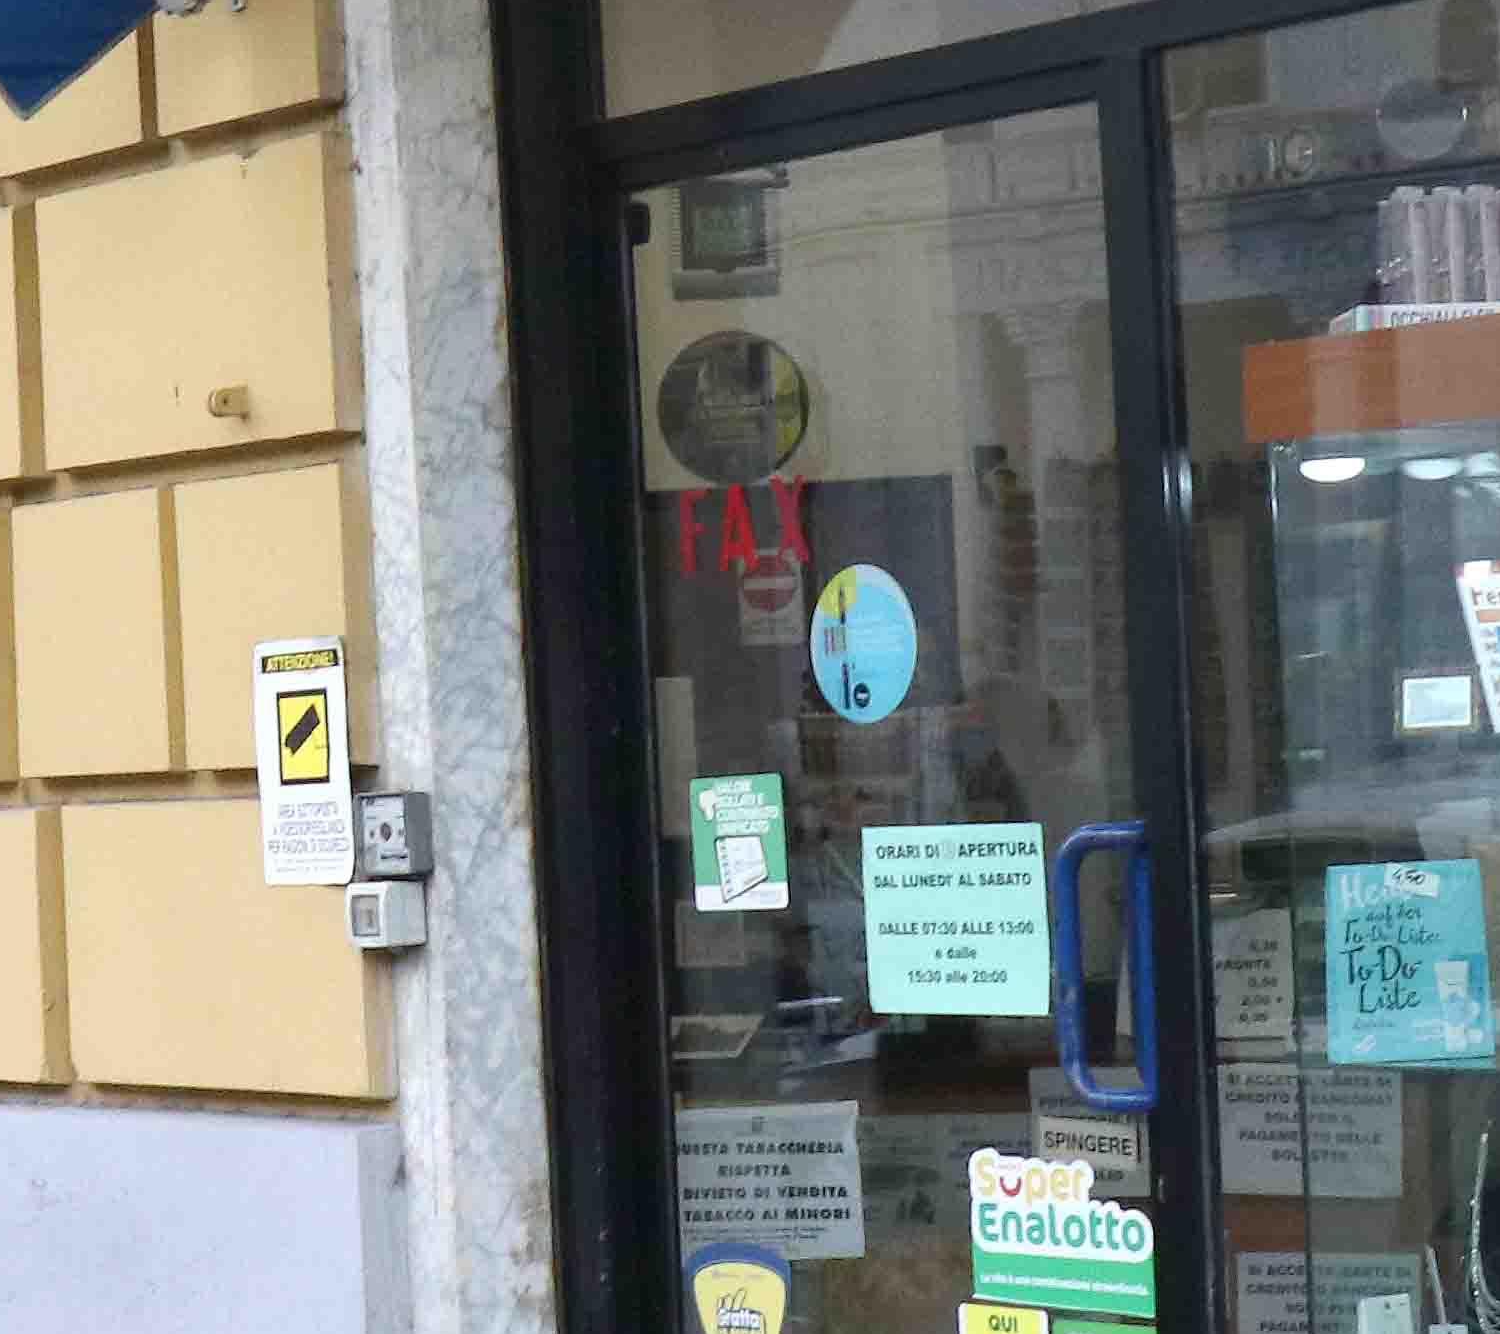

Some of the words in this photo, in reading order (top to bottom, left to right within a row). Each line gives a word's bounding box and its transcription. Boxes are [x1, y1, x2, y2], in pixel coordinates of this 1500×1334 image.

[679, 474, 812, 578] FAX
[876, 844, 920, 859] ORARI
[925, 844, 940, 858] DI
[958, 842, 1038, 857] APERTURA
[874, 874, 898, 888] DAL
[958, 873, 976, 886] AL
[979, 872, 1032, 886] SABATO
[879, 921, 918, 935] DALLE
[961, 921, 994, 935] ALLE
[947, 946, 977, 959] dalle
[945, 970, 967, 983] alle
[1359, 980, 1422, 1014] Liste
[736, 1141, 844, 1155] TABACCHERIA
[1043, 1130, 1133, 1155] SPINGERE
[717, 1164, 792, 1178] RISPETTA
[682, 1186, 746, 1200] DIVIETO
[754, 1186, 770, 1199] DI
[777, 1185, 849, 1198] VENDITA
[683, 1209, 754, 1222] TABACCO
[762, 1209, 778, 1220] AI
[785, 1208, 851, 1220] MINORI
[979, 1201, 1146, 1251] Enalotto
[988, 1314, 1018, 1332] QUI
